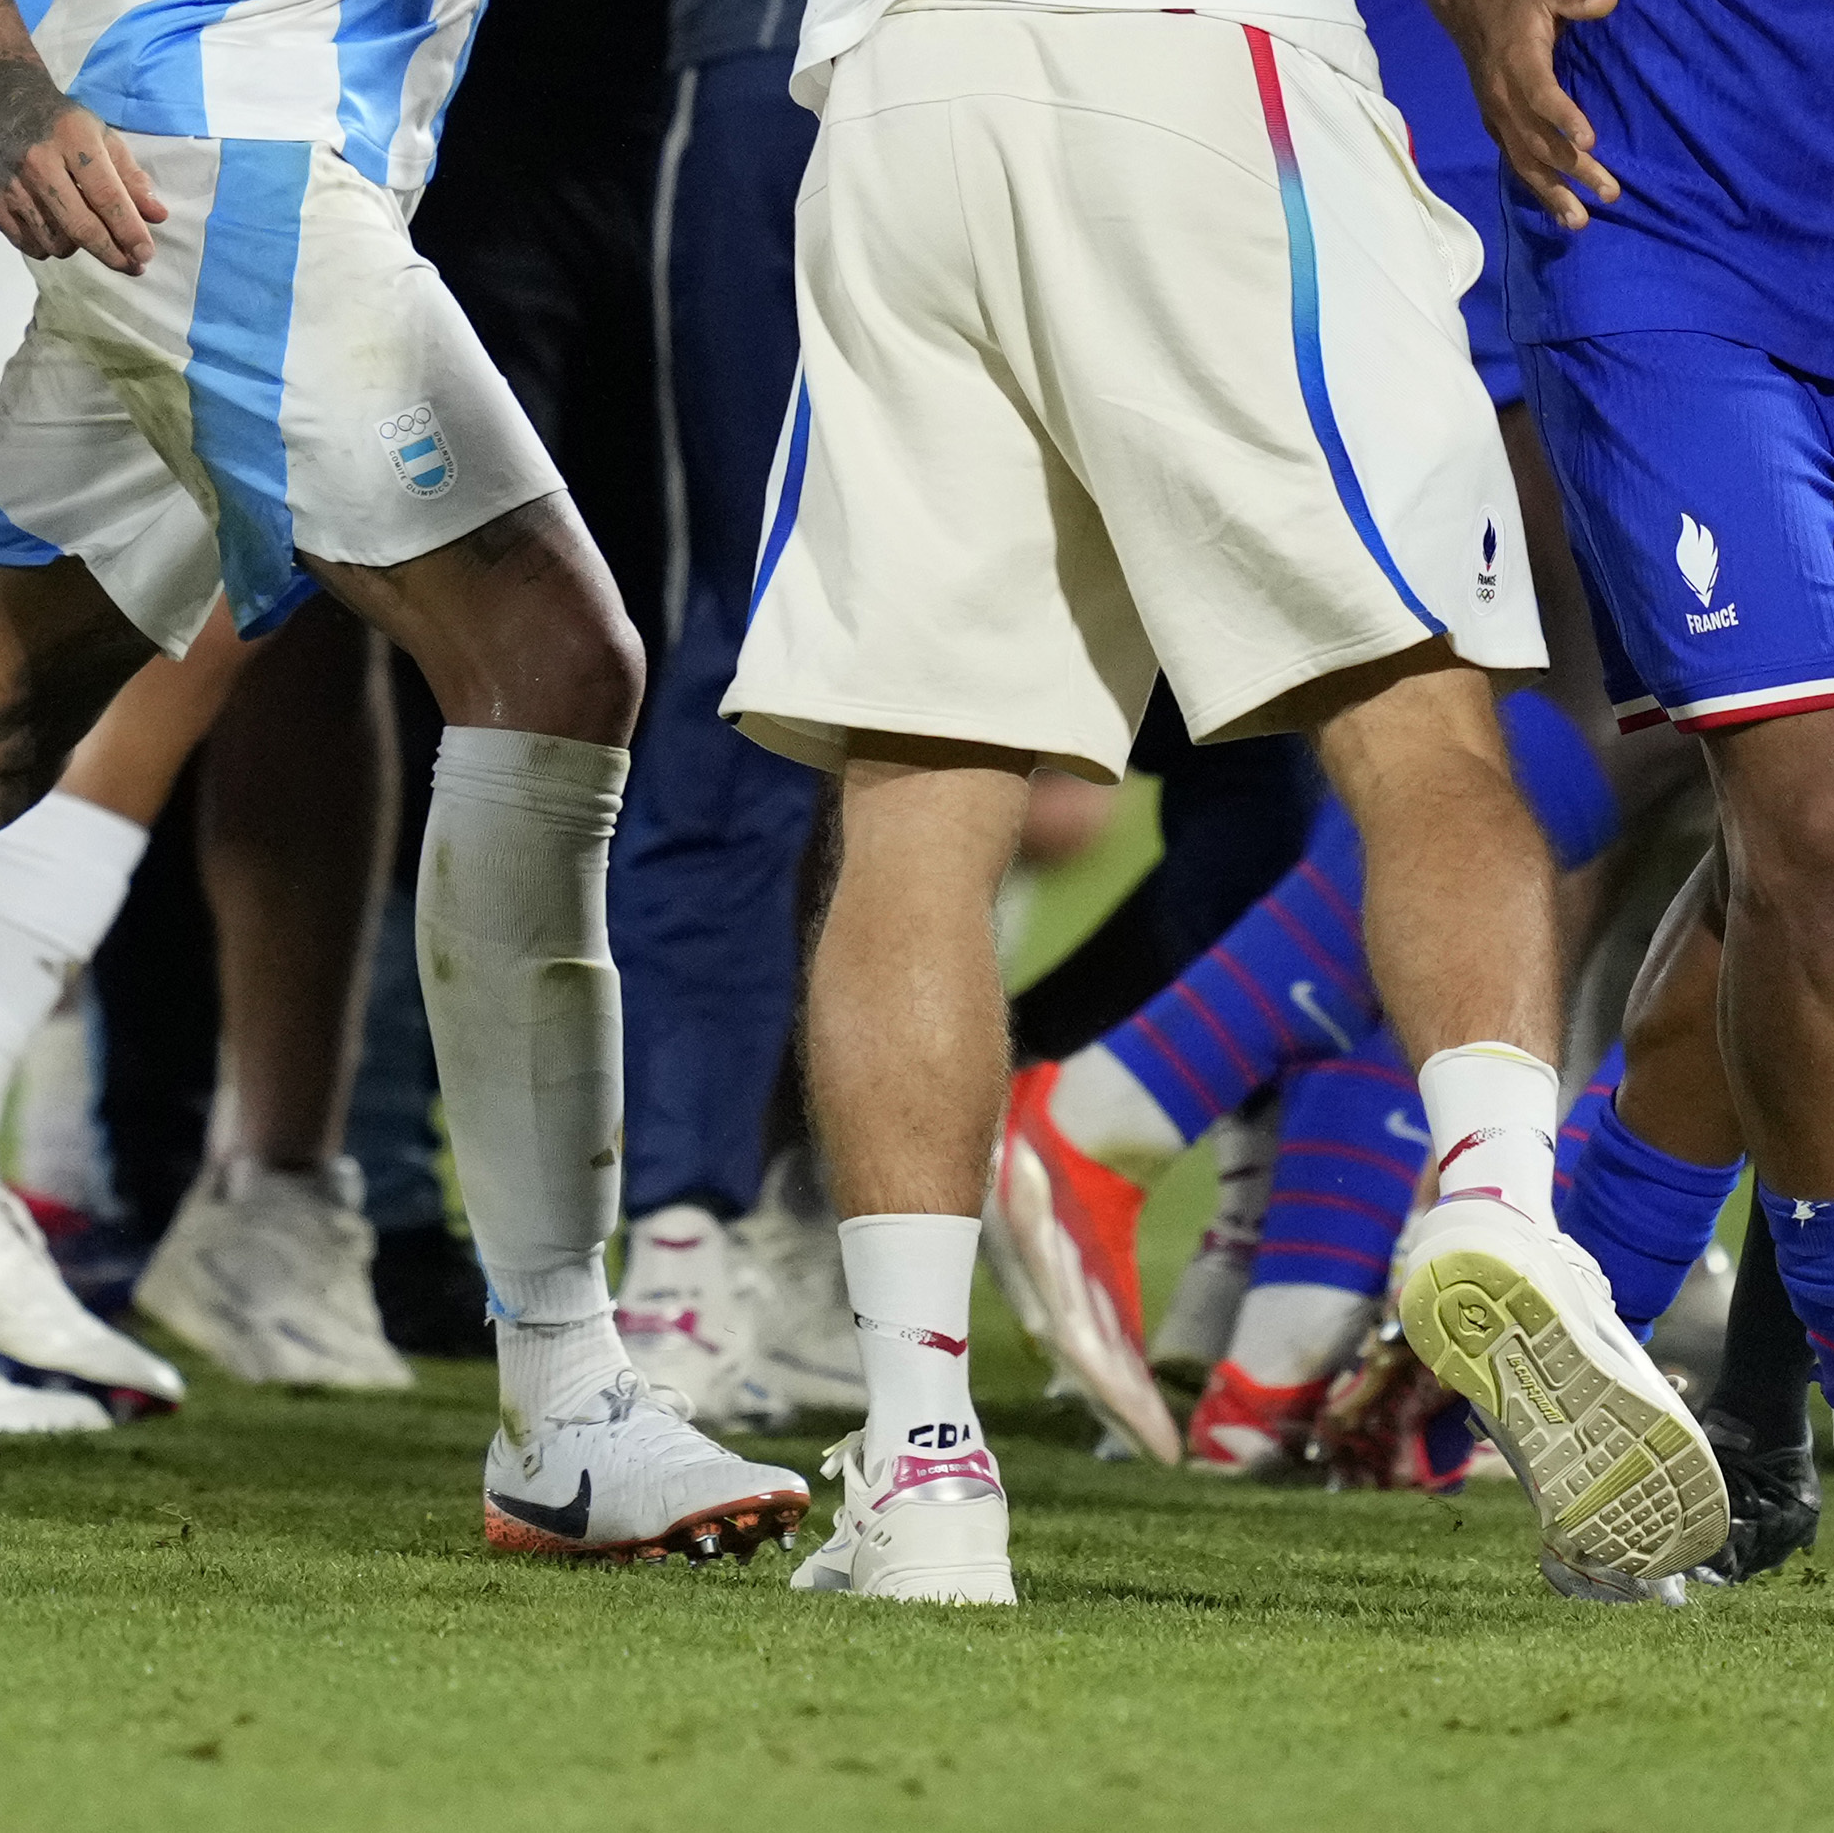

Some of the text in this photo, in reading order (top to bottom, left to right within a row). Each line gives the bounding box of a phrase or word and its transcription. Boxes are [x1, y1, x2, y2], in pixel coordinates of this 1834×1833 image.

[406, 483, 450, 497] OLIMPICO
[1685, 602, 1739, 635] FRANCE
[928, 1464, 949, 1474] coq
